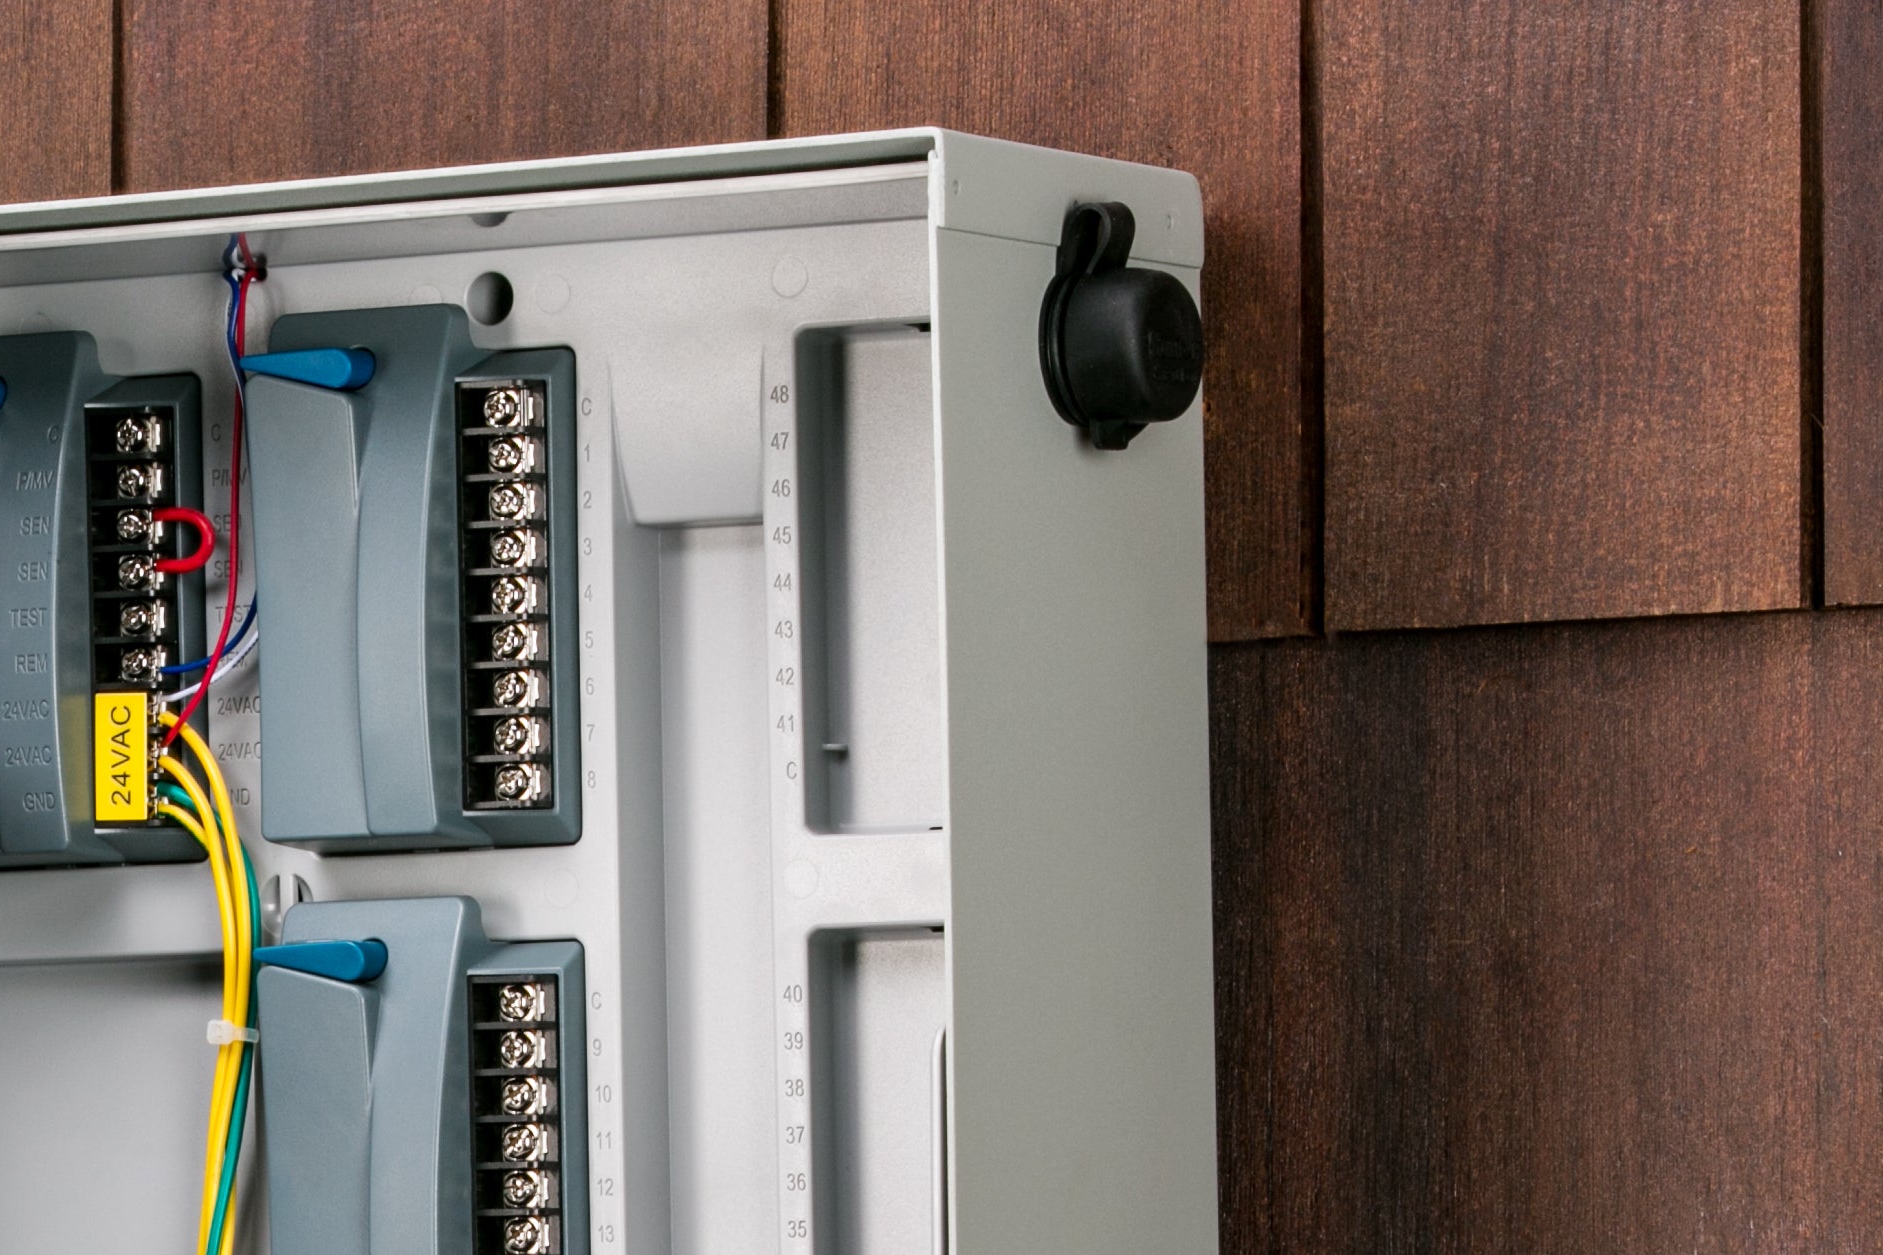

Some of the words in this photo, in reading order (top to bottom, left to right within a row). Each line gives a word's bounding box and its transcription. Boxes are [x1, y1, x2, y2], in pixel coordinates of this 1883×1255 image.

[770, 385, 789, 404] 48
[770, 432, 790, 451] 47
[772, 479, 791, 498] 46
[20, 516, 50, 536] SEN
[772, 526, 792, 545] 45
[18, 561, 48, 581] SEN
[773, 573, 792, 592] 44
[9, 607, 47, 628] TEST
[774, 621, 794, 639] 43
[15, 653, 48, 673] REM
[775, 668, 795, 686] 42
[2, 699, 50, 720] 24VAC
[777, 715, 795, 733] 41
[5, 745, 53, 767] 24VAC
[111, 705, 131, 806] 24VAC
[23, 792, 55, 812] GND
[783, 985, 803, 1004] 40
[784, 1032, 804, 1051] 39
[596, 1085, 612, 1104] 10
[785, 1079, 805, 1098] 38
[786, 1126, 806, 1145] 37
[598, 1179, 614, 1197] 12
[786, 1173, 807, 1192] 36
[598, 1225, 615, 1244] 13
[787, 1220, 808, 1239] 35
